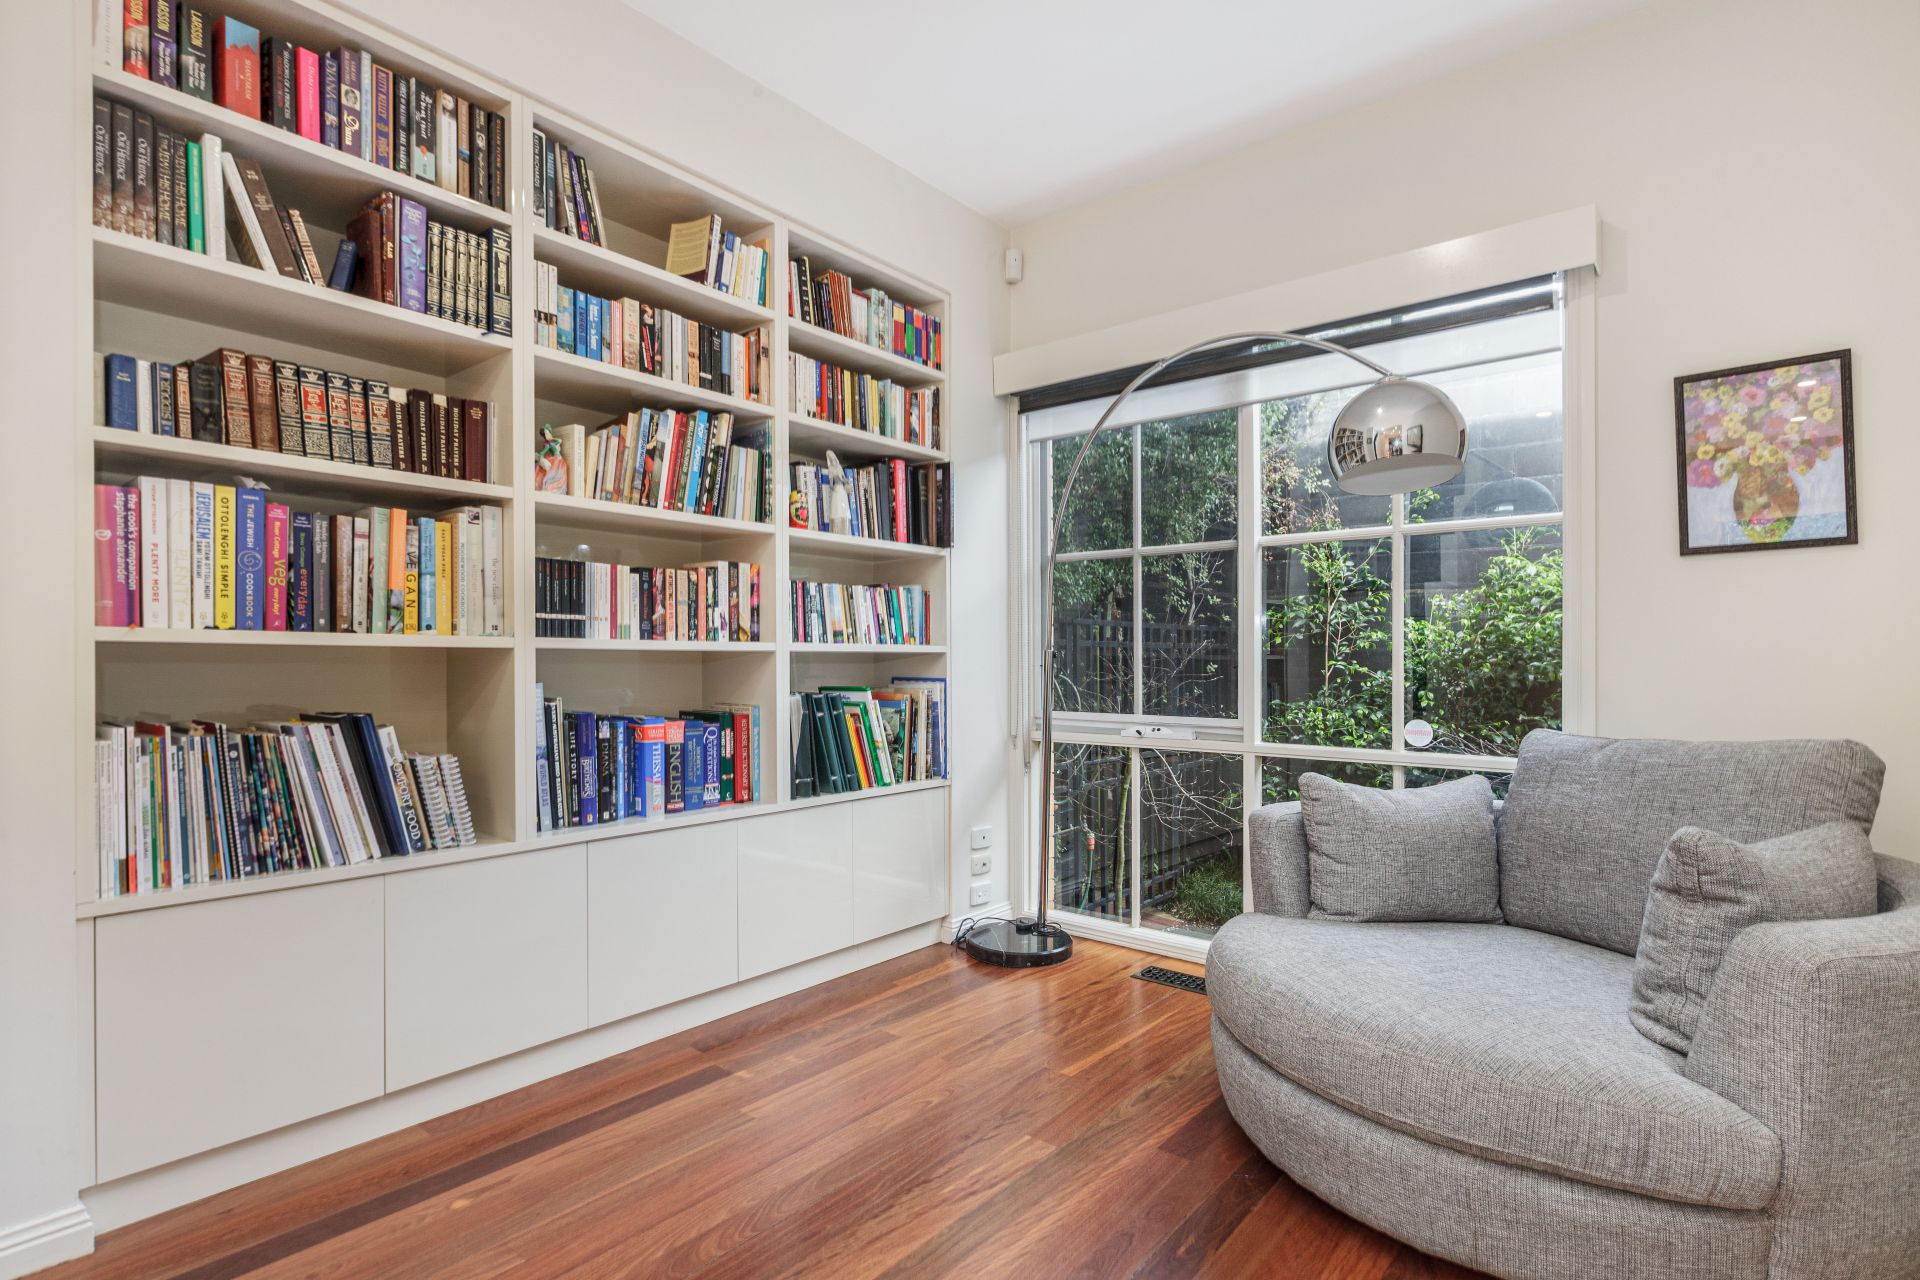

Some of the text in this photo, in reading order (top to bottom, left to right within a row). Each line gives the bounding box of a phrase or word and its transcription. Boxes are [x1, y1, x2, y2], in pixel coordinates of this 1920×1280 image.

[190, 10, 203, 48] LARSSON
[308, 66, 316, 86] Diana
[326, 60, 337, 98] DIANA
[378, 71, 387, 118] KITTY KELLEY
[343, 110, 360, 146] Diana
[95, 142, 104, 175] HERITAGE
[117, 149, 126, 180] HERITAGE
[138, 155, 146, 186] HERITAGE
[160, 148, 171, 168] JEW
[176, 156, 186, 174] JEW
[400, 146, 408, 169] HARPER
[160, 174, 171, 189] HIS
[176, 181, 187, 196] HIS
[160, 190, 170, 221] HOME
[176, 197, 187, 226] HOME
[196, 492, 212, 540] JERUSALEM
[314, 520, 322, 540] Cooking
[114, 492, 127, 584] stephanie alexander
[127, 494, 138, 590] the cook's companion
[220, 497, 229, 598] OTTOLENGHI SIMPLE
[272, 536, 281, 558] Cottage
[150, 543, 160, 603] PLENTY MORE
[175, 548, 189, 606] PLENTY
[246, 504, 254, 616] THE JEWISH COOKBOOK
[268, 560, 288, 587] veg
[406, 550, 417, 608] VEGAN
[602, 742, 610, 777] DIANA
[670, 743, 682, 802] ENGLISH
[703, 726, 718, 784] QUOTATIONS
[540, 764, 549, 808] WORLD ATLAS
[652, 744, 662, 806] THESAURUS
[406, 810, 421, 840] FOOD
